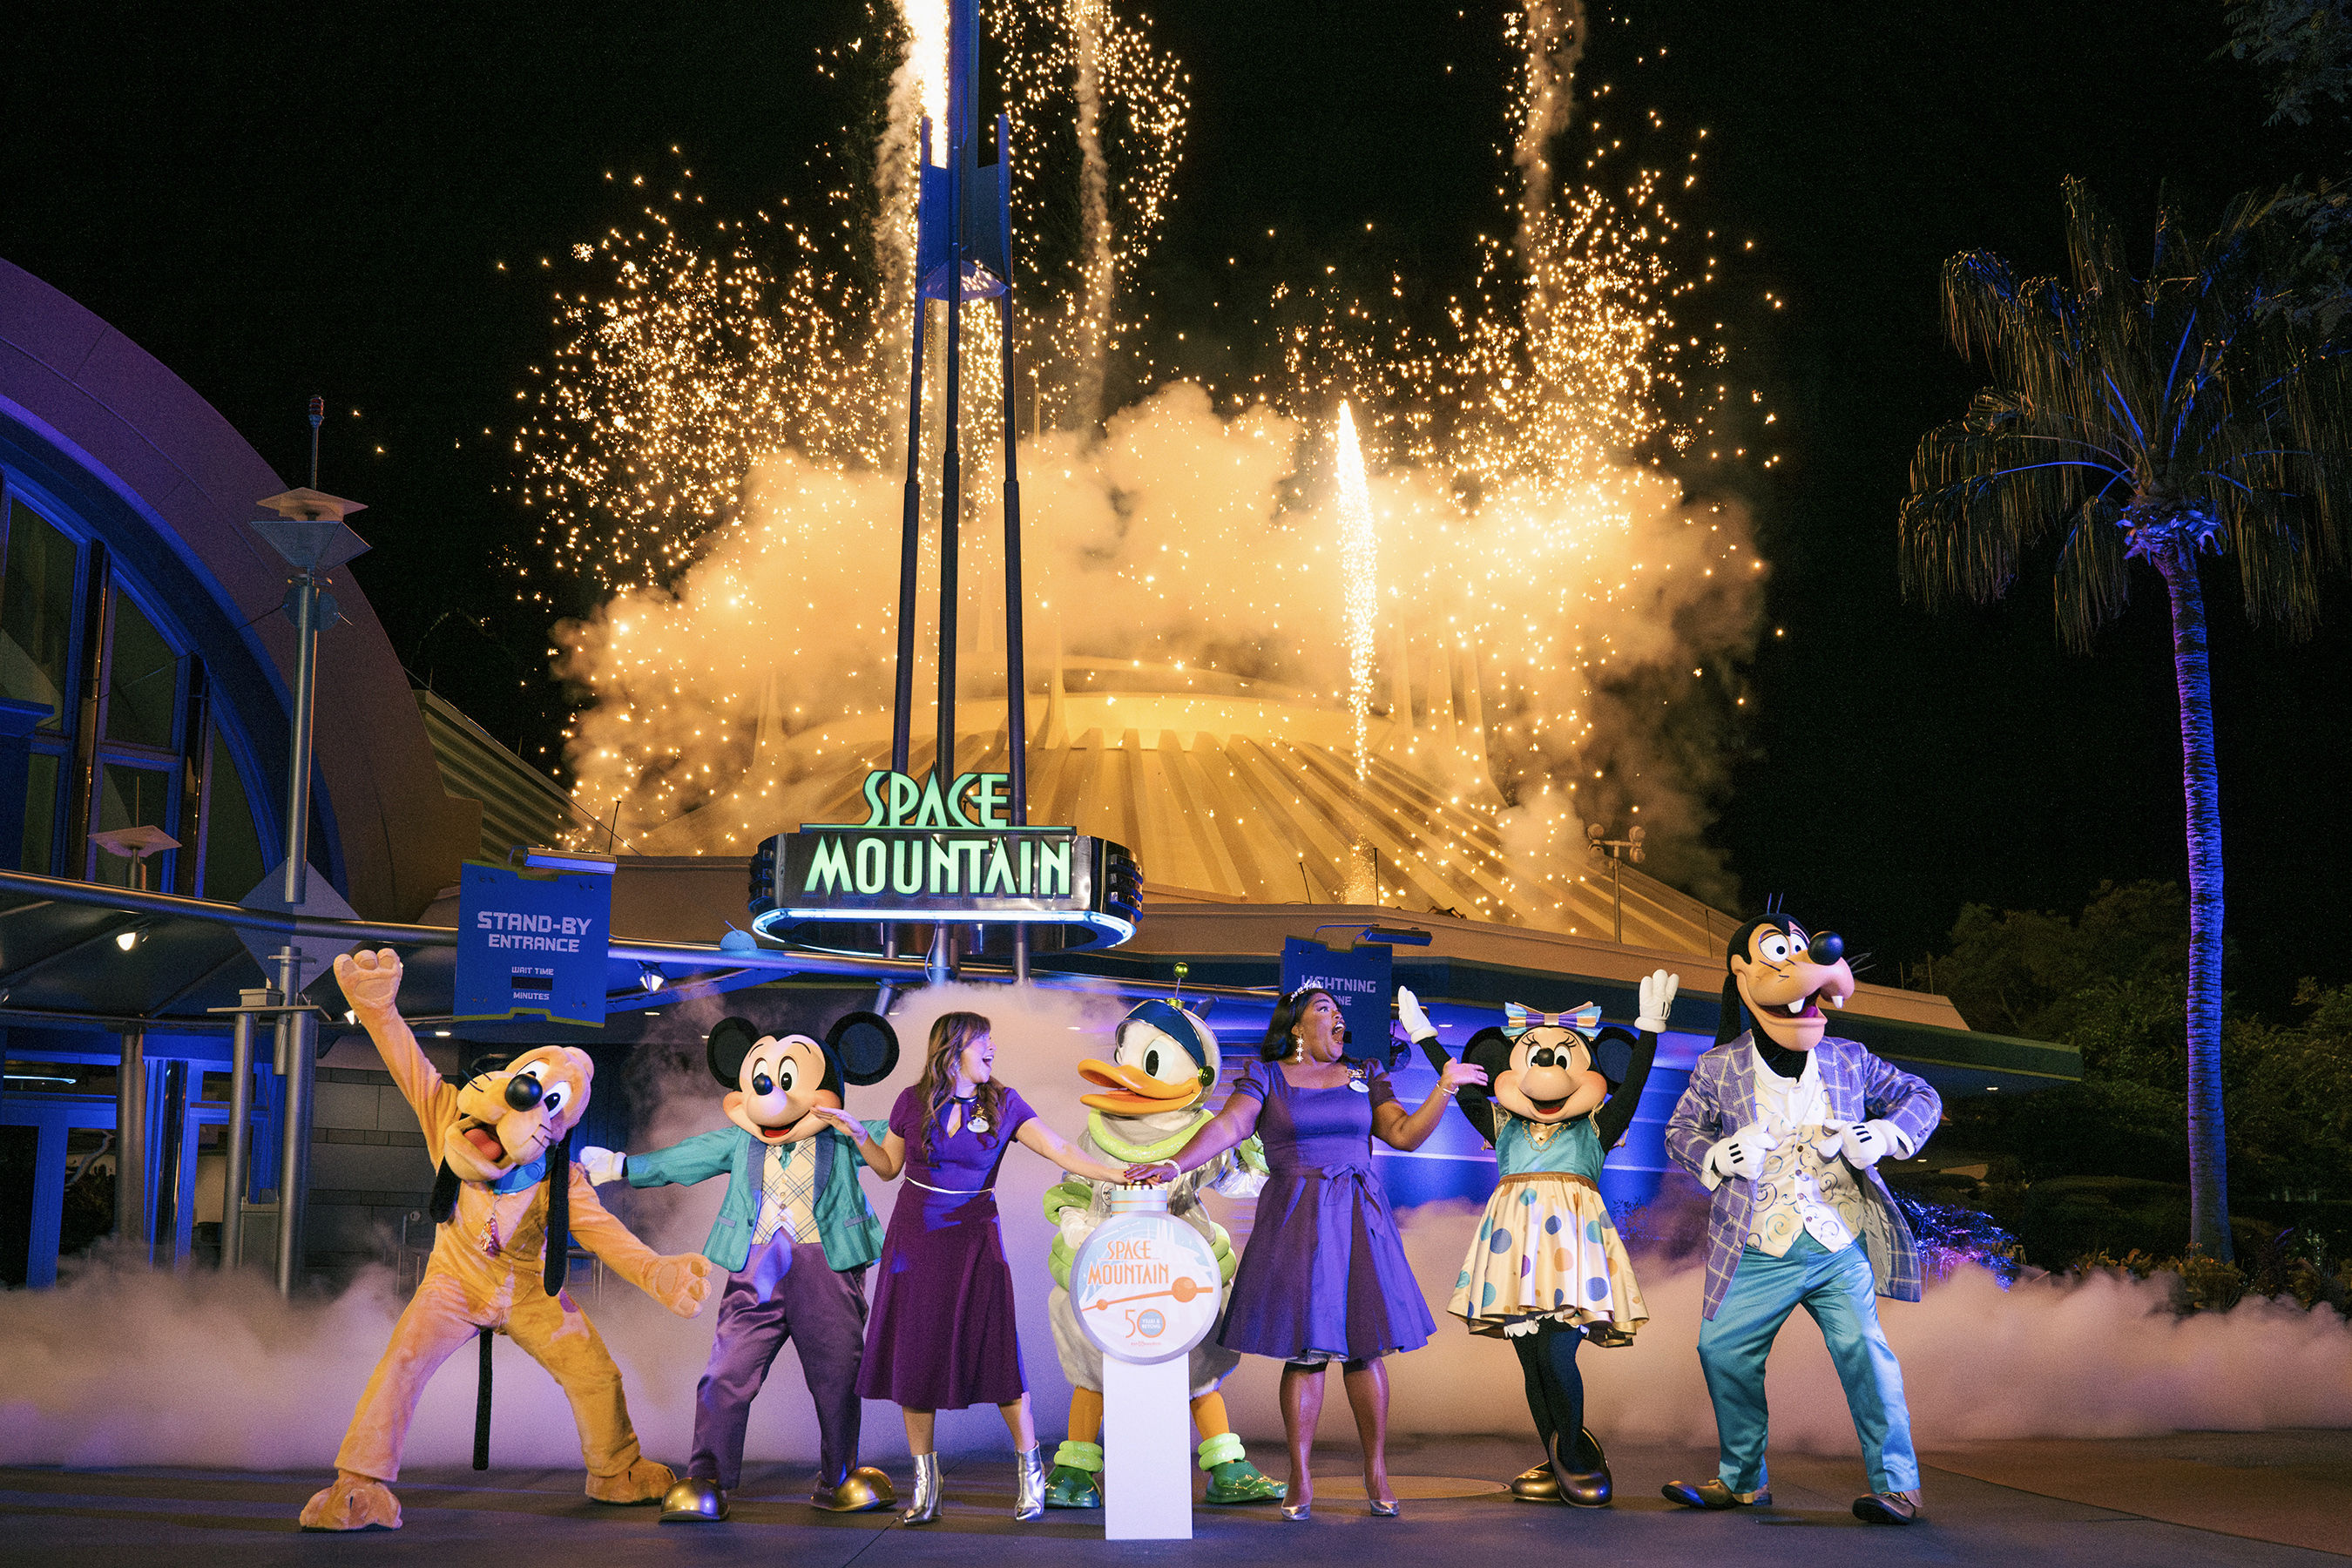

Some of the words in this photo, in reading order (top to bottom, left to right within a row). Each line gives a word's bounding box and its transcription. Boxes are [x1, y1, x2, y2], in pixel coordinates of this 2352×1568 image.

[863, 769, 1009, 828] SPACE
[804, 834, 1071, 896] MOUNTAIN
[477, 911, 592, 935] STAND-BY
[489, 934, 579, 952] ENTRANCE
[513, 991, 550, 1001] MINUTES
[1107, 1240, 1151, 1260] SPACE
[1087, 1262, 1169, 1285] MOUNTAIN
[1125, 1308, 1166, 1338] 50
